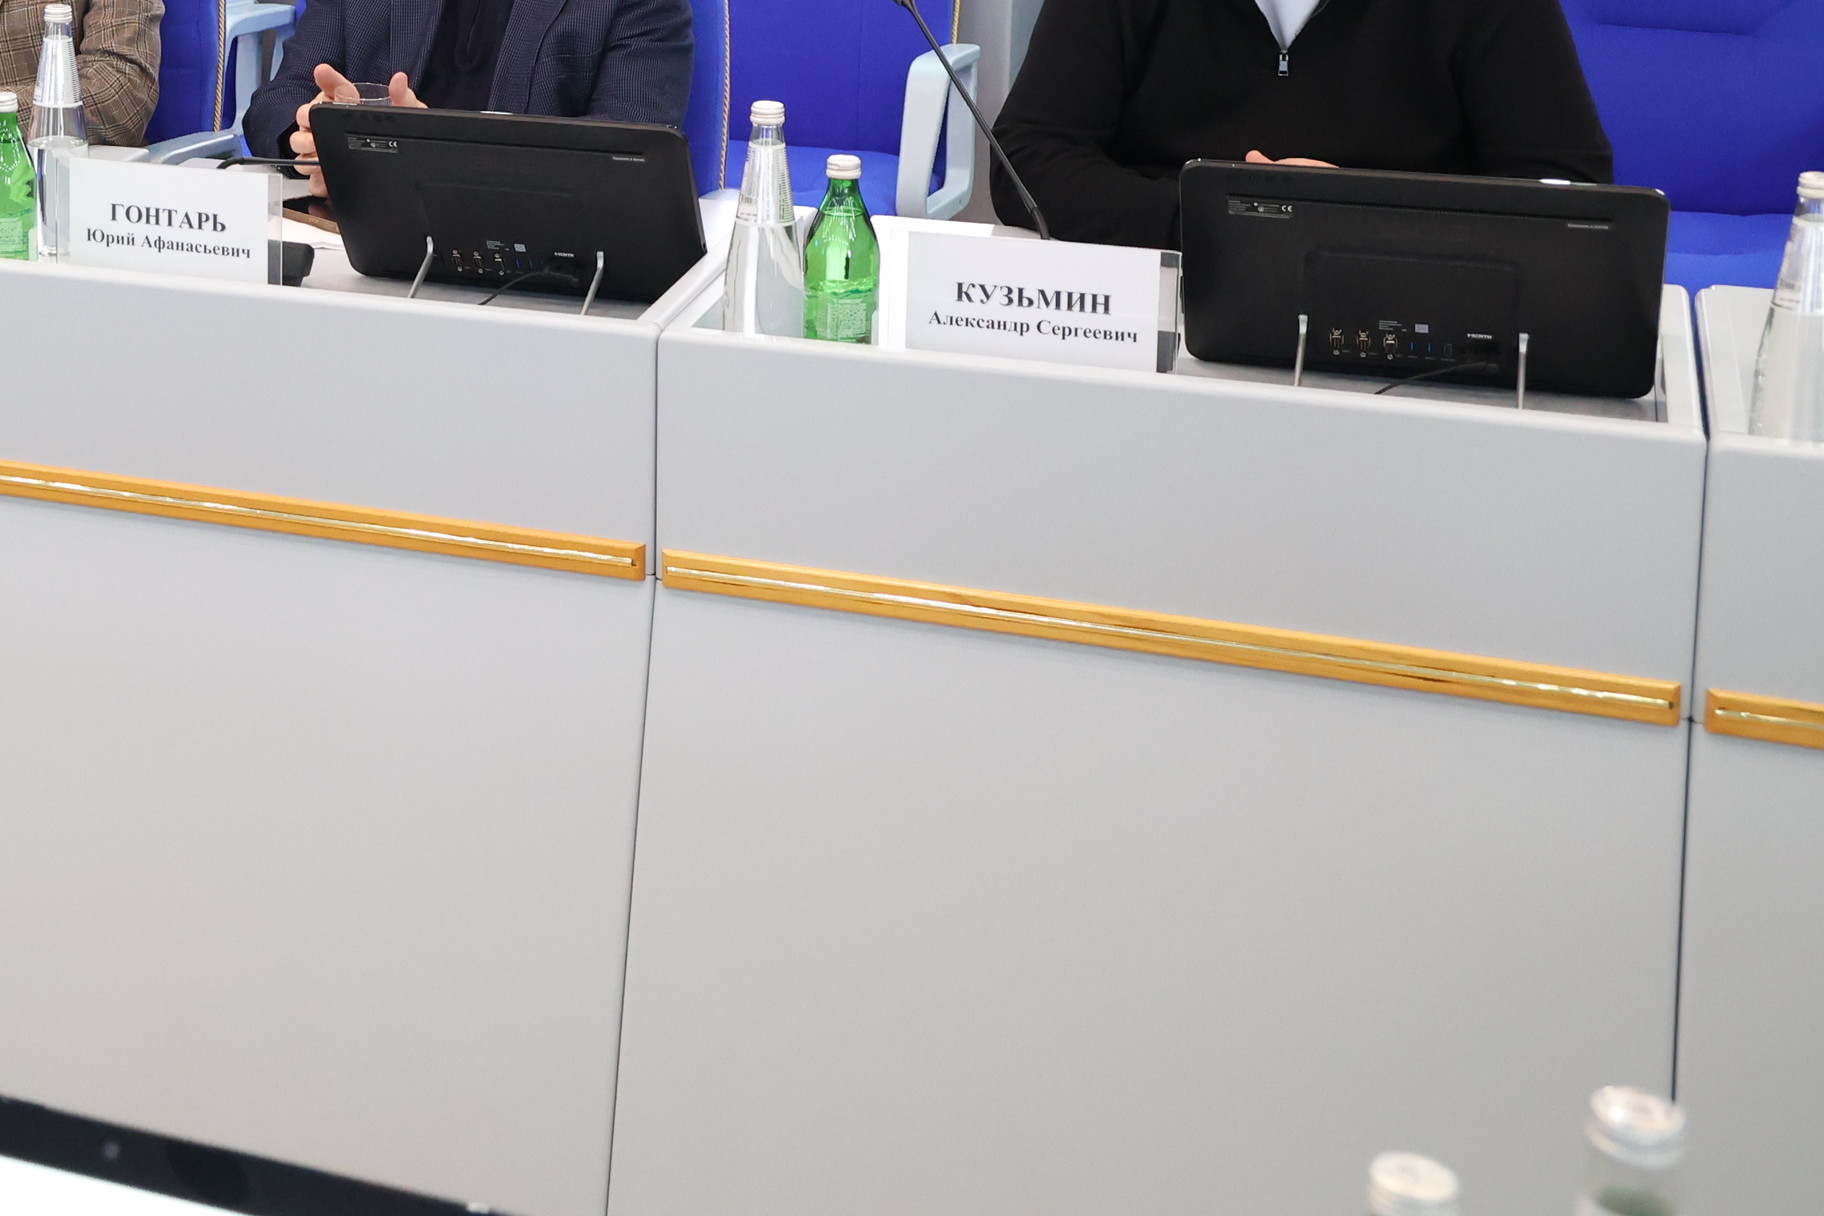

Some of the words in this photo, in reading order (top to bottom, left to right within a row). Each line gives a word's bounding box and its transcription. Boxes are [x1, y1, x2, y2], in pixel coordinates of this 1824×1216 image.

[110, 203, 227, 233] ГОНТАРЬ
[87, 227, 136, 247] Юрий
[141, 234, 251, 259] Афанасьевич
[955, 281, 1112, 316] КУЗЬМИН
[928, 310, 1030, 336] Александр
[1036, 319, 1138, 343] Сергеевич
